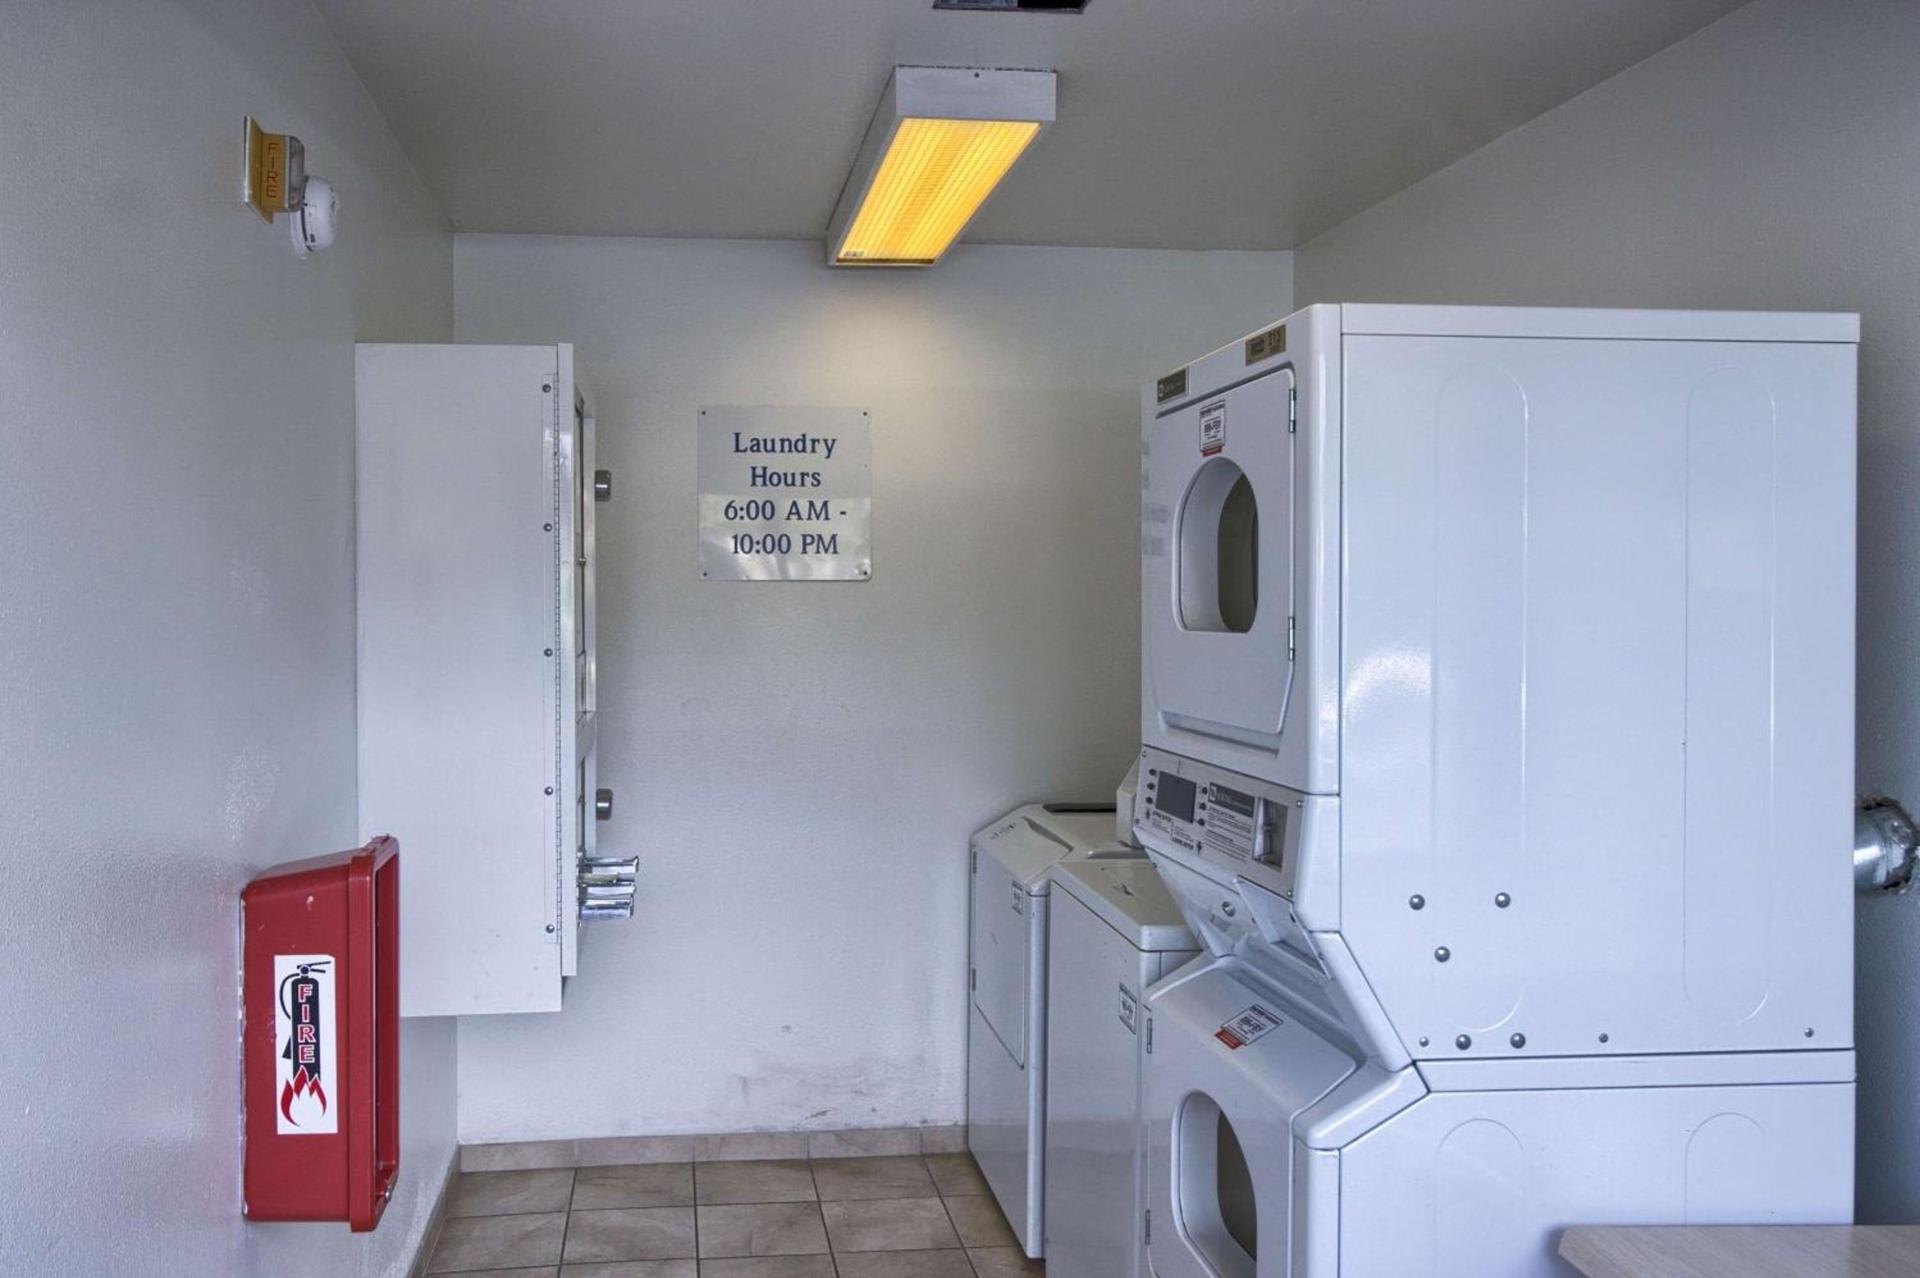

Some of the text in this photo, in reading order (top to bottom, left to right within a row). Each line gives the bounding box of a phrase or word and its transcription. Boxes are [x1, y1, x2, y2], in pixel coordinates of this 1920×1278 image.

[266, 142, 280, 198] FIRE
[732, 432, 838, 459] Laundry
[750, 466, 822, 488] Hours
[723, 499, 776, 521] 6:00
[784, 500, 831, 521] AM
[732, 533, 839, 555] 10:00 PM
[297, 983, 317, 1064] FIRE
